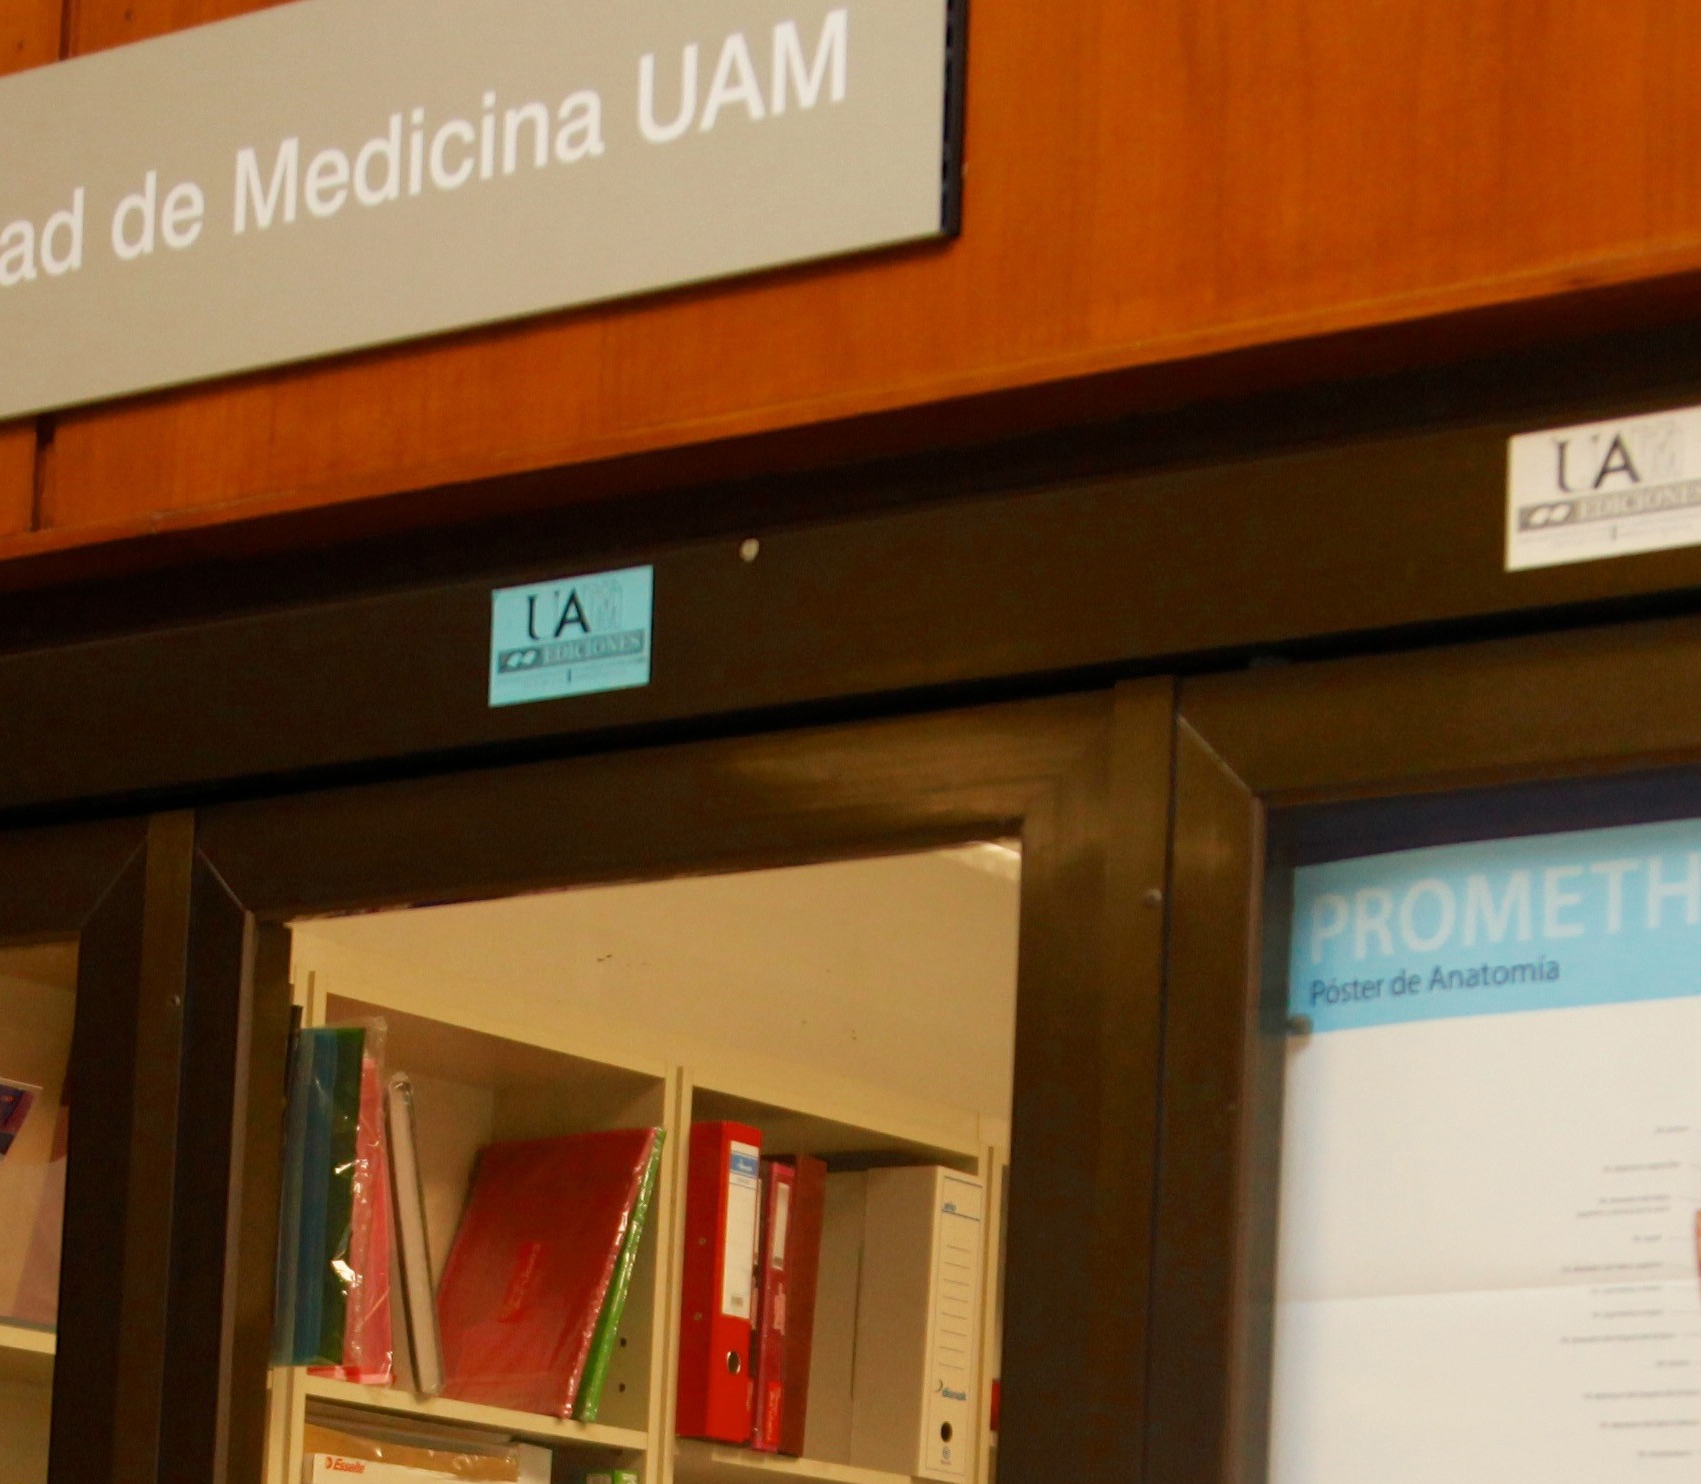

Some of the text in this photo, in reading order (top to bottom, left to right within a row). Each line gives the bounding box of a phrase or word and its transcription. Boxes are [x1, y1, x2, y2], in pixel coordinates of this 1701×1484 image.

[110, 170, 204, 260] de
[234, 89, 605, 235] Medicina
[637, 8, 848, 145] UAM
[1310, 953, 1560, 1007] Póster de Anatomía
[333, 1458, 365, 1473] Esselte
